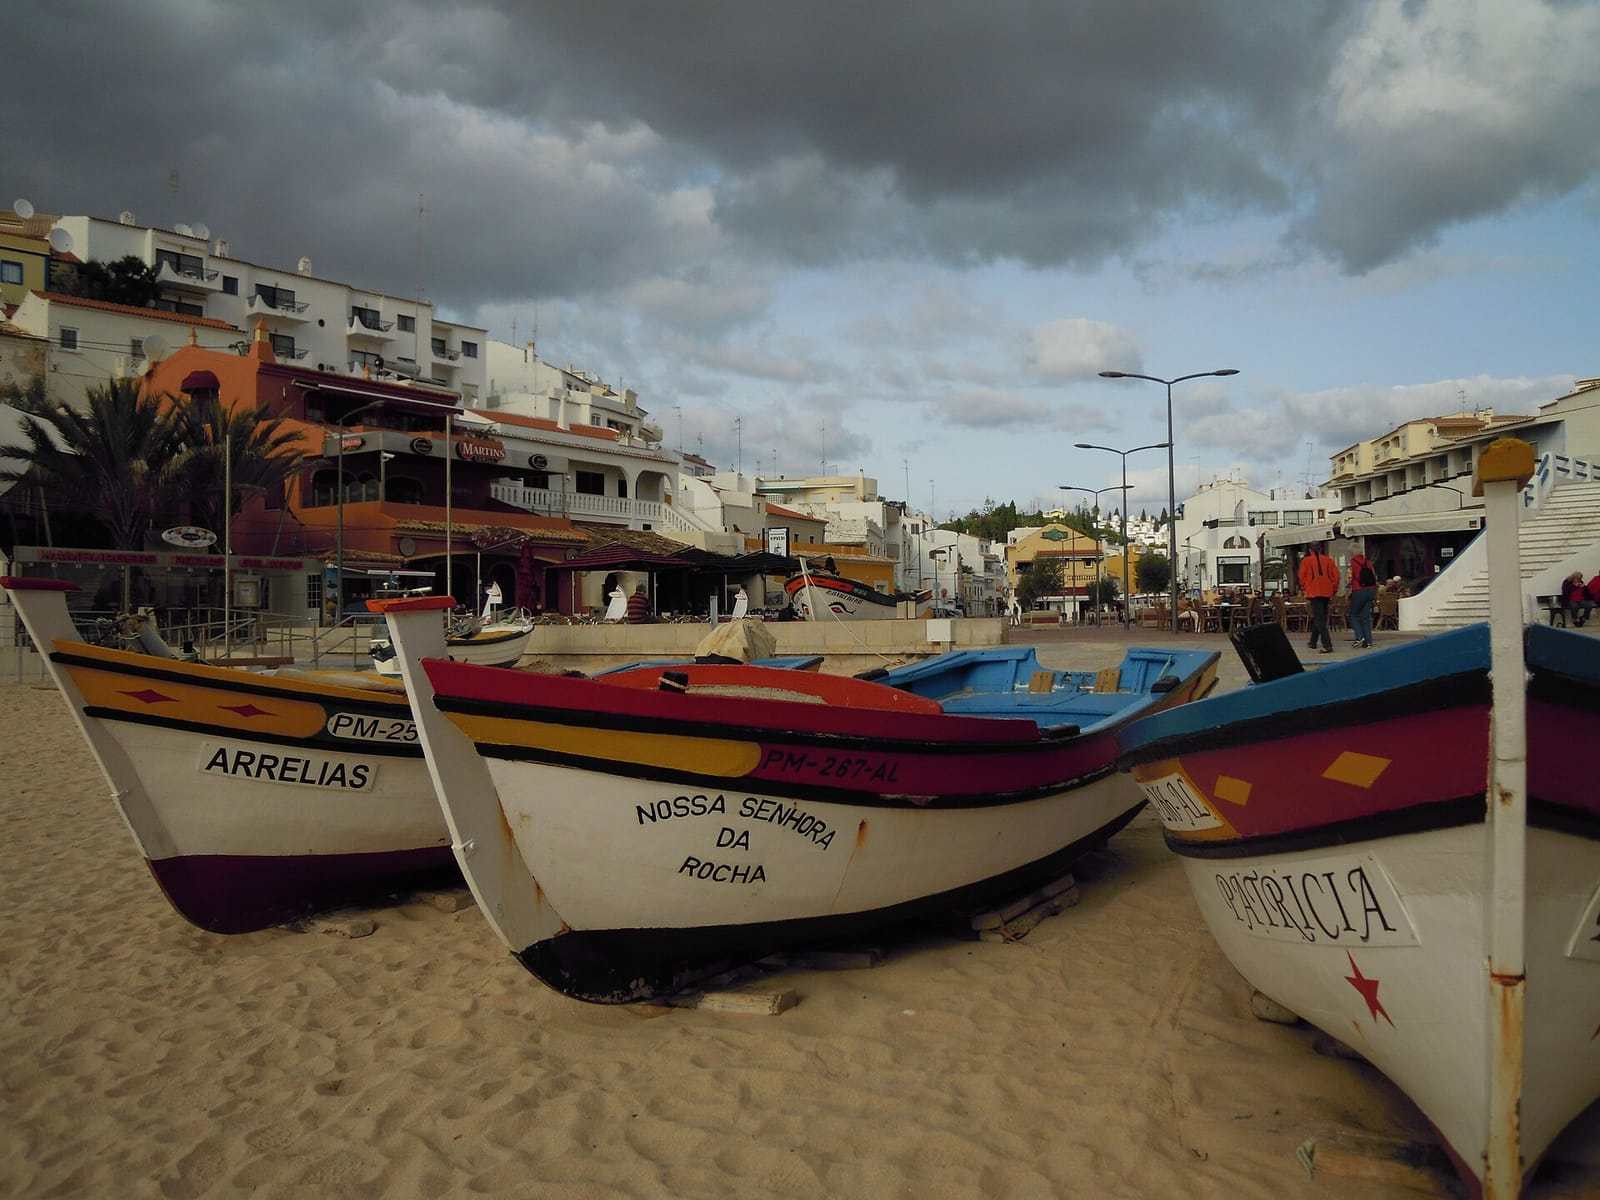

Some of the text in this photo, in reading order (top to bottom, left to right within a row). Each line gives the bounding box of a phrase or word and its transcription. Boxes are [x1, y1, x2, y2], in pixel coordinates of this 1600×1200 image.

[463, 442, 505, 457] MARTINS
[205, 747, 370, 789] ARRELIAS
[762, 750, 899, 783] PM-267-AL
[636, 794, 837, 850] NOSSA SENHORA
[716, 827, 750, 851] DA
[678, 856, 767, 884] ROCHA
[1215, 865, 1397, 943] PATRICIA
